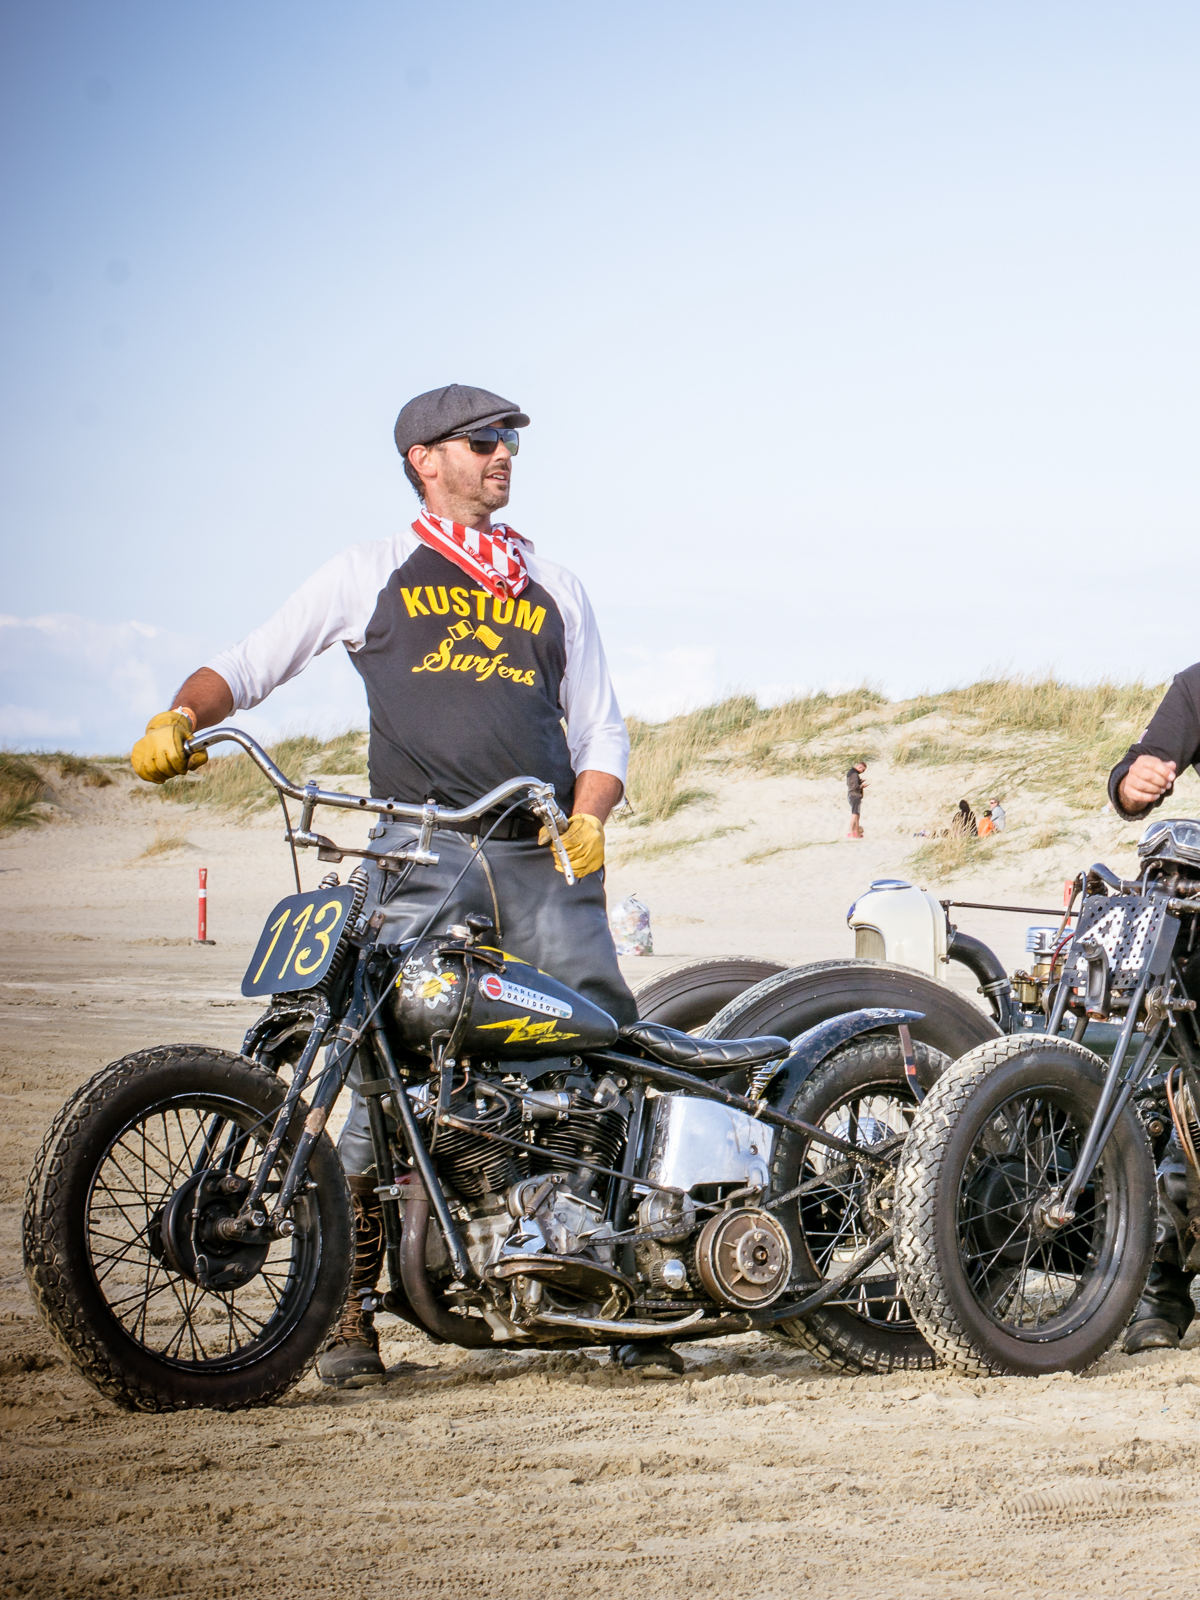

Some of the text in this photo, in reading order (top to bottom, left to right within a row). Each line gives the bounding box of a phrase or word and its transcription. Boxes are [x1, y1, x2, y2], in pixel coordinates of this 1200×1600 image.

[400, 585, 547, 635] KUSTOM
[412, 638, 535, 686] Surfers
[252, 900, 343, 984] 113
[506, 992, 558, 1014] DAVIDSON
